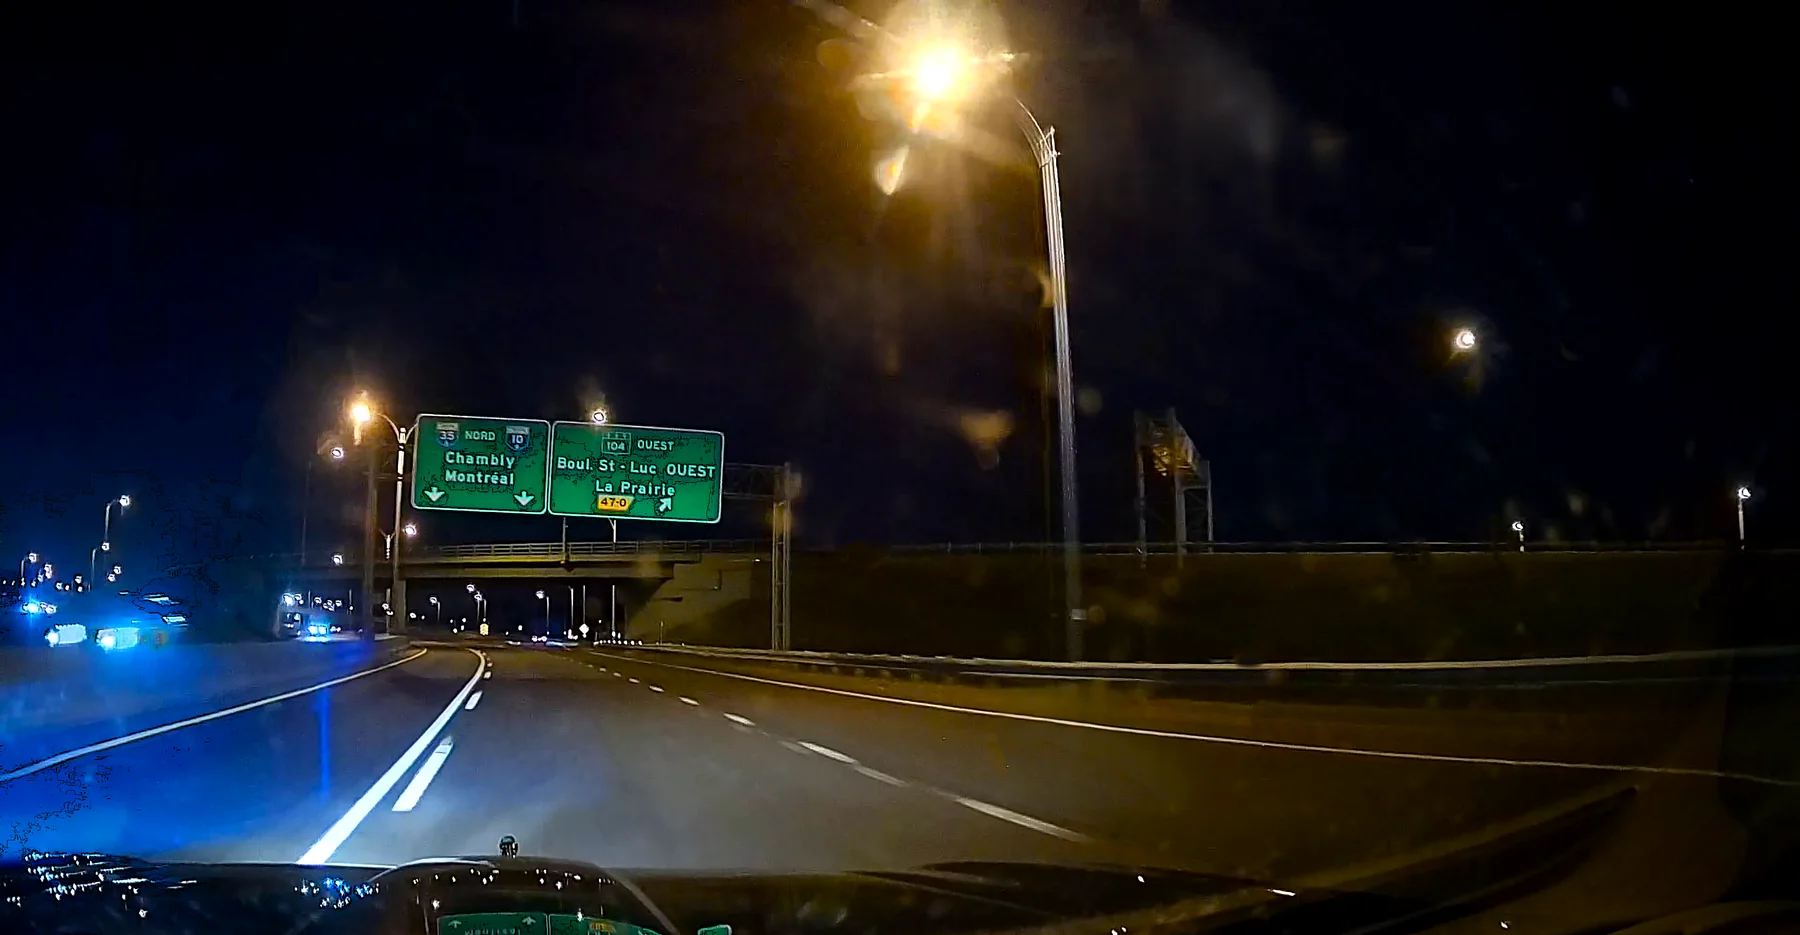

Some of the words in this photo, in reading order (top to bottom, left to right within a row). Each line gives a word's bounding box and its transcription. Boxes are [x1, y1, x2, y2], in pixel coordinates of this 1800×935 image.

[439, 430, 455, 441] 35
[465, 430, 496, 441] NORD
[511, 434, 524, 444] 10
[606, 441, 626, 451] 104
[637, 439, 675, 451] OUEST
[445, 451, 515, 469] Chambly
[557, 456, 593, 470] Boul.
[666, 463, 716, 478] OUEST
[445, 469, 514, 485] Montréal
[596, 479, 613, 493] La
[620, 481, 676, 497] Prairie
